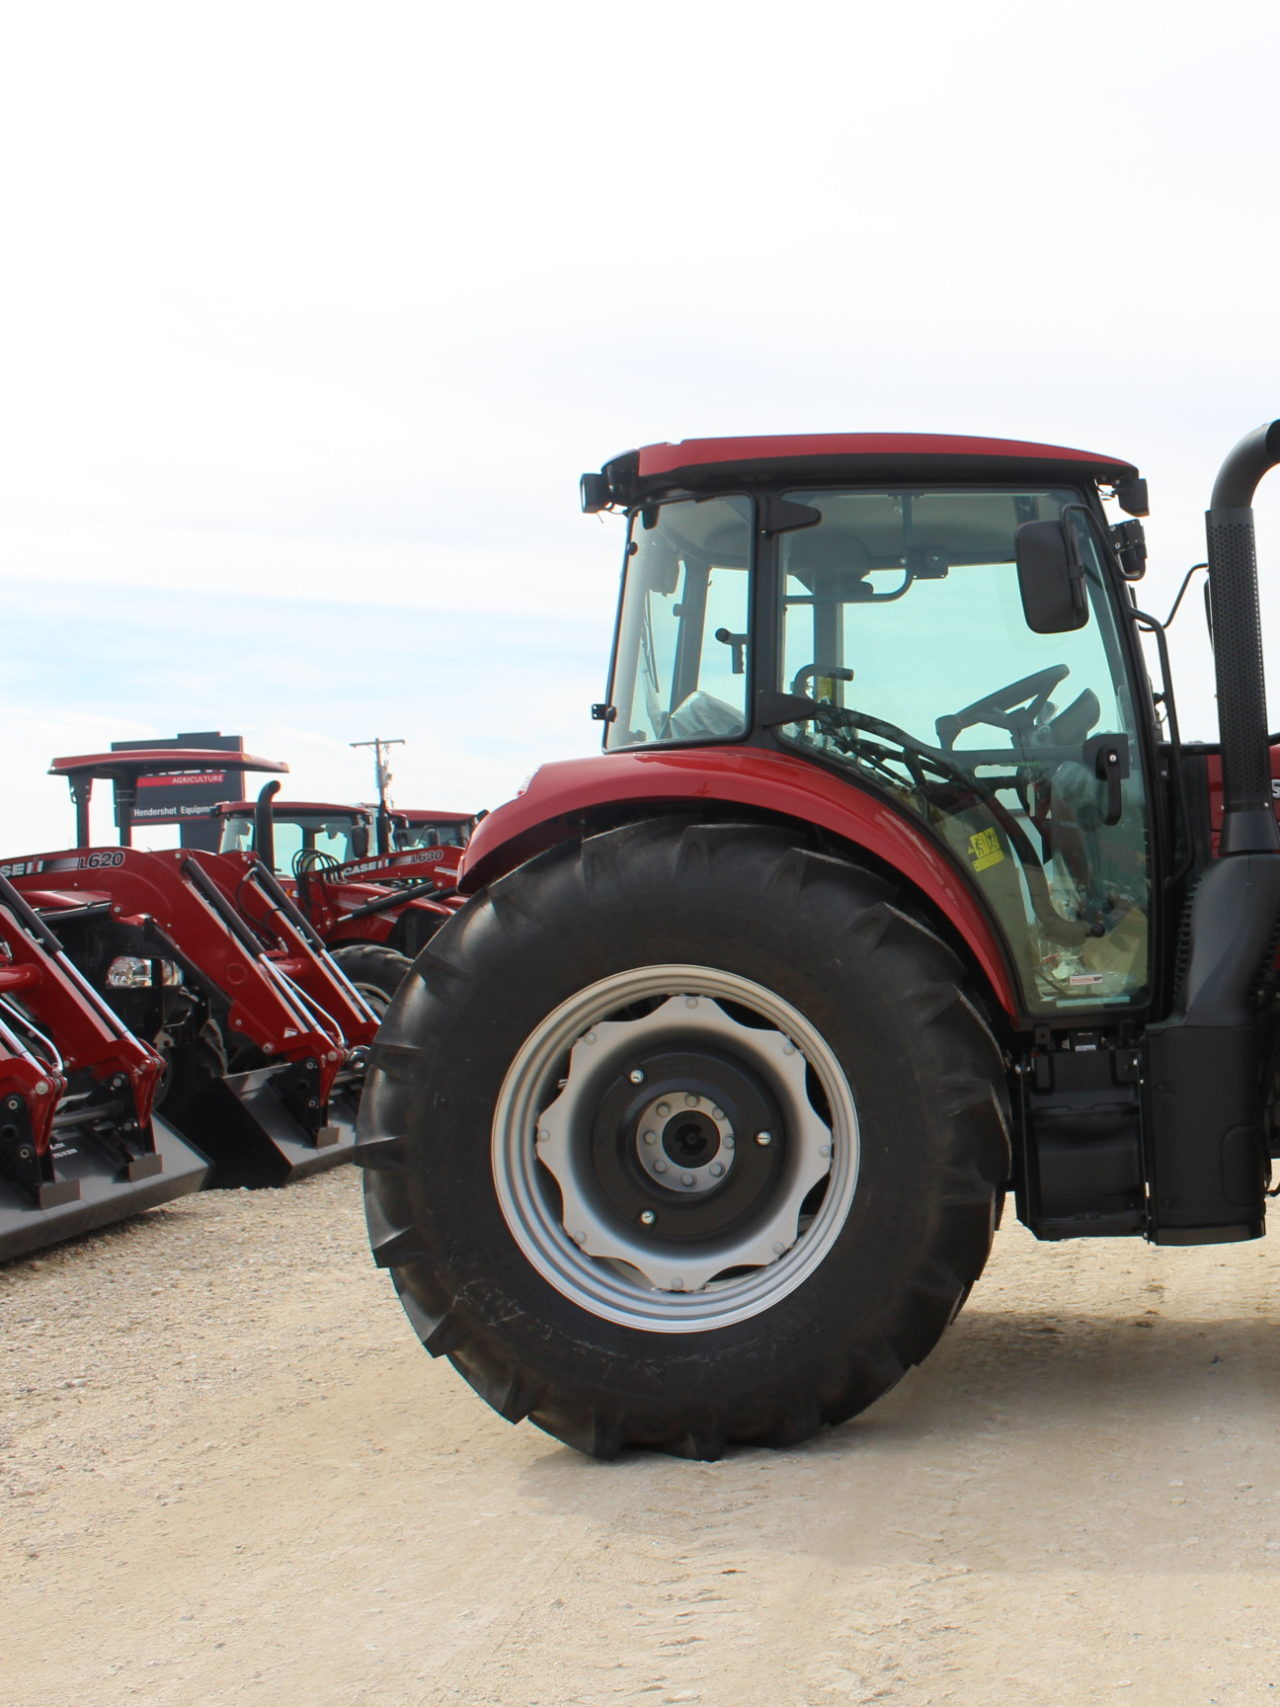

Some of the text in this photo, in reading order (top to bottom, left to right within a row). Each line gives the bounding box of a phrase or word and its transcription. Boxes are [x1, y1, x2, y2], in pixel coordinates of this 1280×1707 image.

[171, 774, 224, 784] AGRICULTURE
[133, 806, 177, 816] Hendershot
[79, 851, 125, 870] L620
[343, 860, 377, 876] CASE
